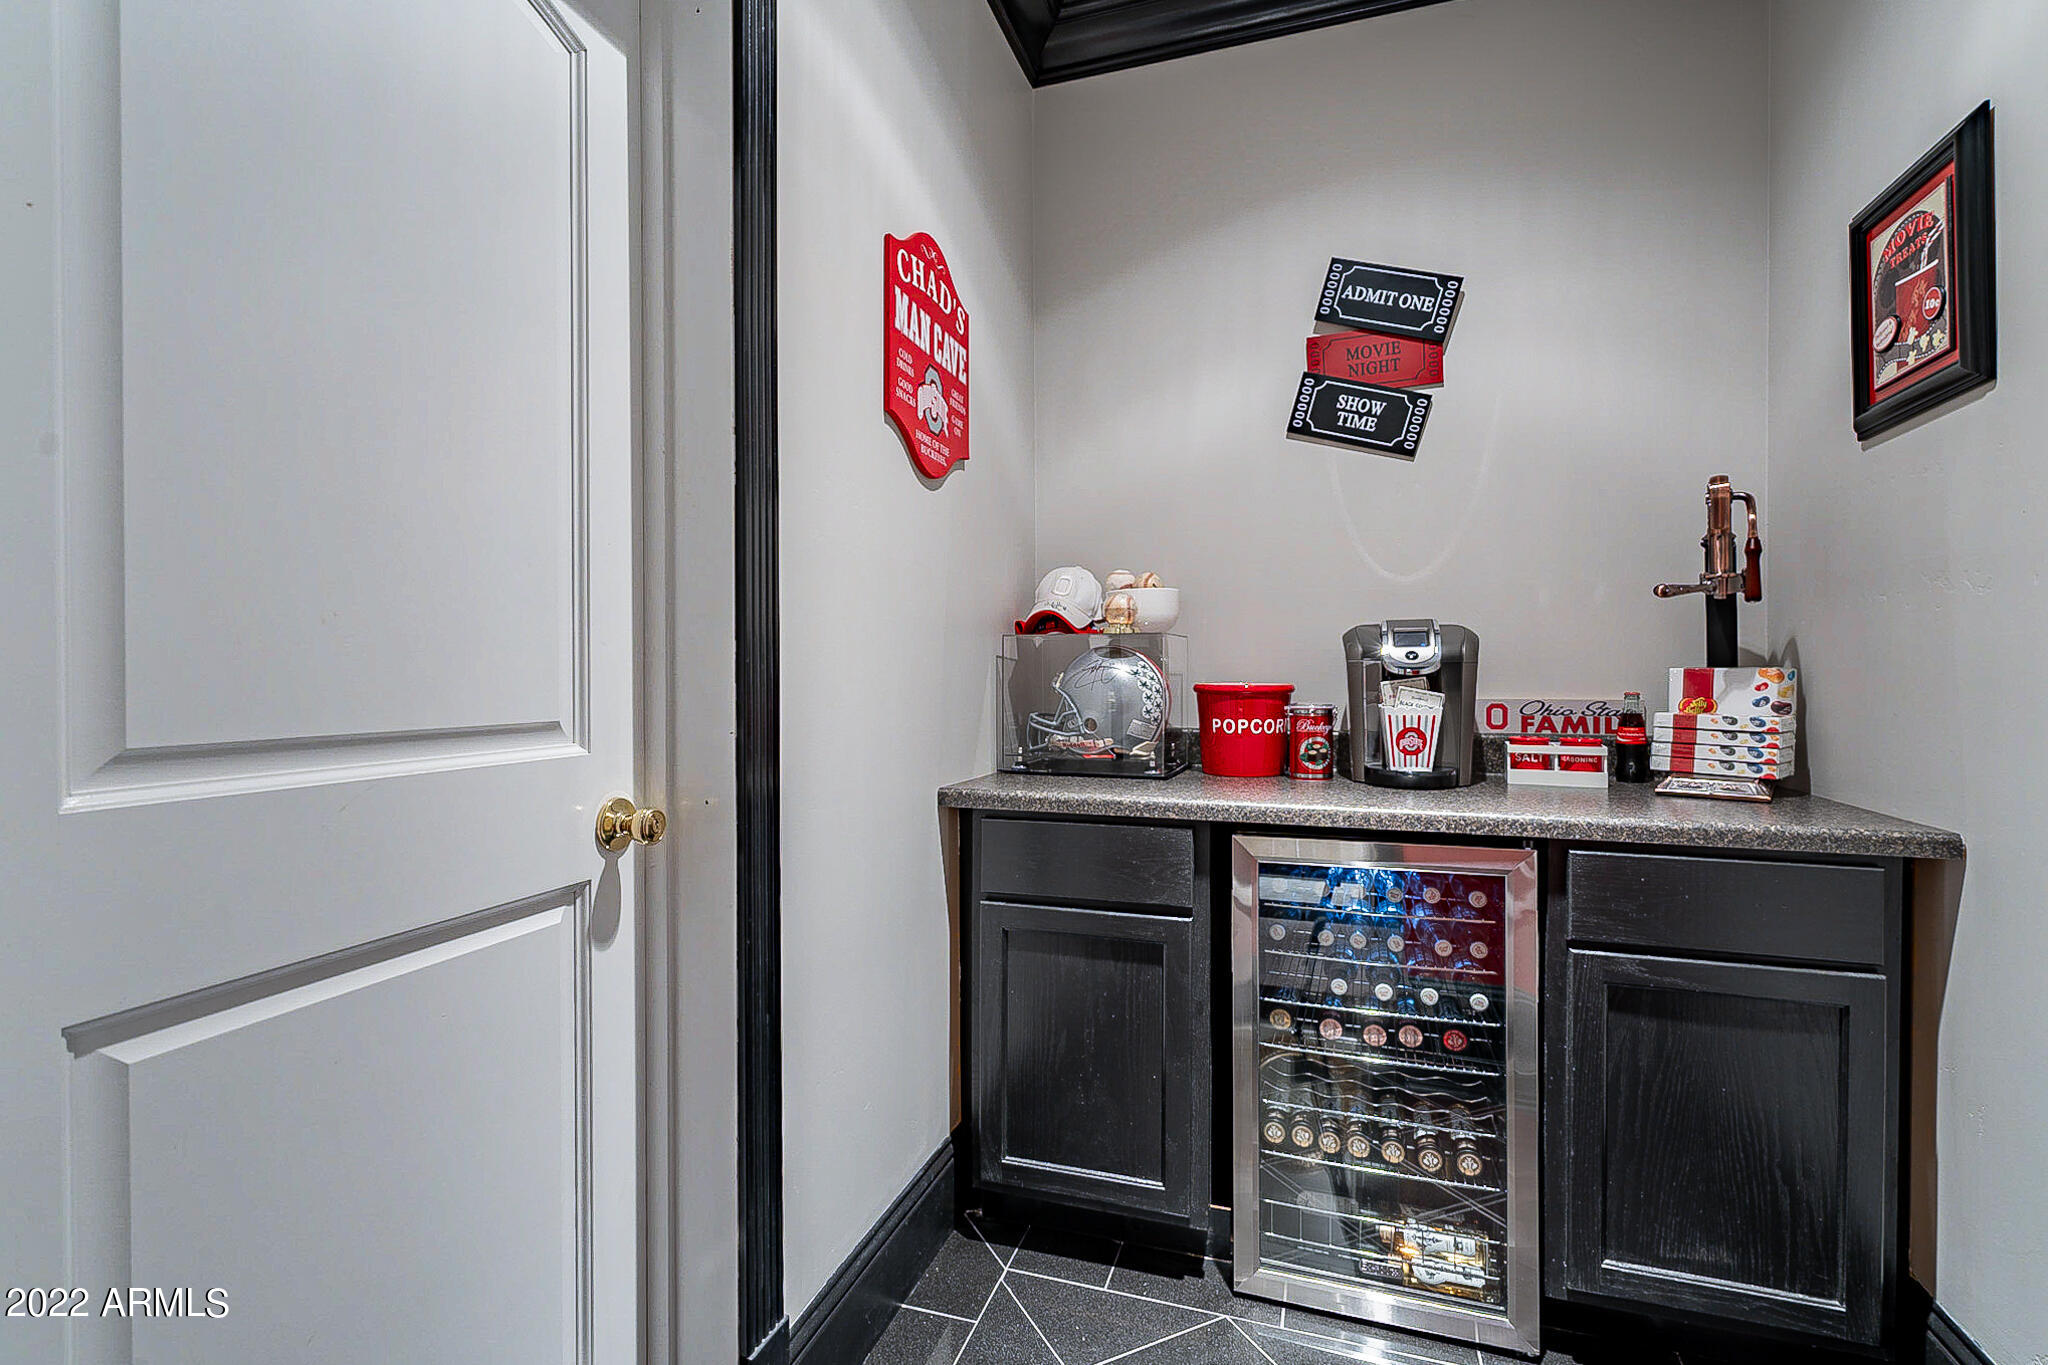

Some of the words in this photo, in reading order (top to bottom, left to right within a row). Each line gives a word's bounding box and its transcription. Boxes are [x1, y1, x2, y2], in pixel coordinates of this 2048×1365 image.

[1882, 211, 1935, 263] MOVIE
[1889, 232, 1928, 269] TREATS
[897, 248, 966, 335] CHAD'S
[1341, 285, 1398, 306] ADMIT
[1399, 293, 1435, 312] ONE
[894, 284, 931, 356] MAN
[933, 322, 967, 385] CAVE
[1346, 341, 1401, 361] MOVIE
[1348, 358, 1400, 377] NIGHT
[1336, 394, 1387, 416] SHOW
[1337, 412, 1378, 432] TIME
[1520, 700, 1577, 716] Ohio
[1581, 700, 1622, 716] Sta
[1521, 715, 1620, 734] FAMIL
[1515, 752, 1543, 763] SALT
